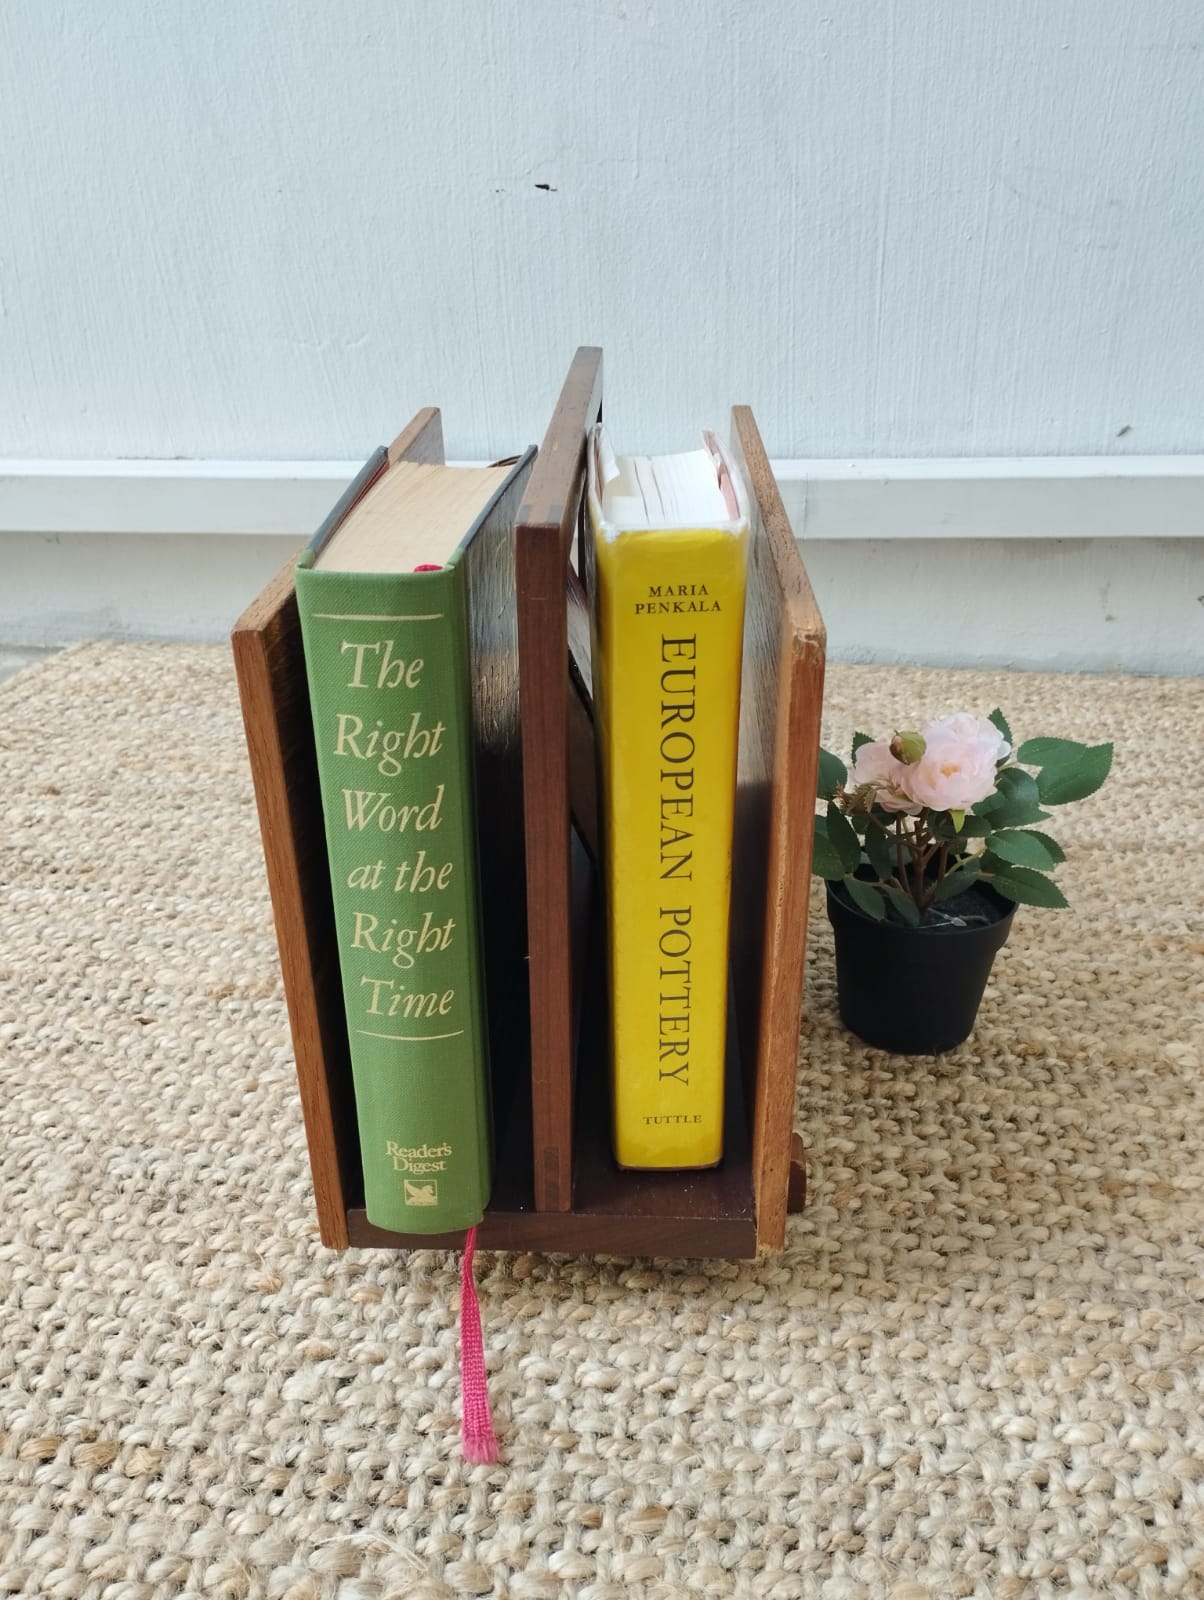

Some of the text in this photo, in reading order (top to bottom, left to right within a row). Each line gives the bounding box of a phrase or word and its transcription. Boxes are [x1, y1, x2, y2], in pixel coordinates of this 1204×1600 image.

[634, 600, 722, 615] PENKALA
[648, 584, 709, 598] MARIA
[340, 640, 425, 689] The
[333, 712, 447, 777] Right
[341, 784, 445, 833] Word
[347, 850, 454, 893] at the
[658, 633, 697, 1086] EUROPEAN POTTERY
[351, 912, 457, 969] Right
[360, 976, 455, 1018] Time
[642, 1114, 702, 1125] TUTTLE
[385, 1140, 453, 1159] Reader's
[392, 1156, 448, 1175] Digest
